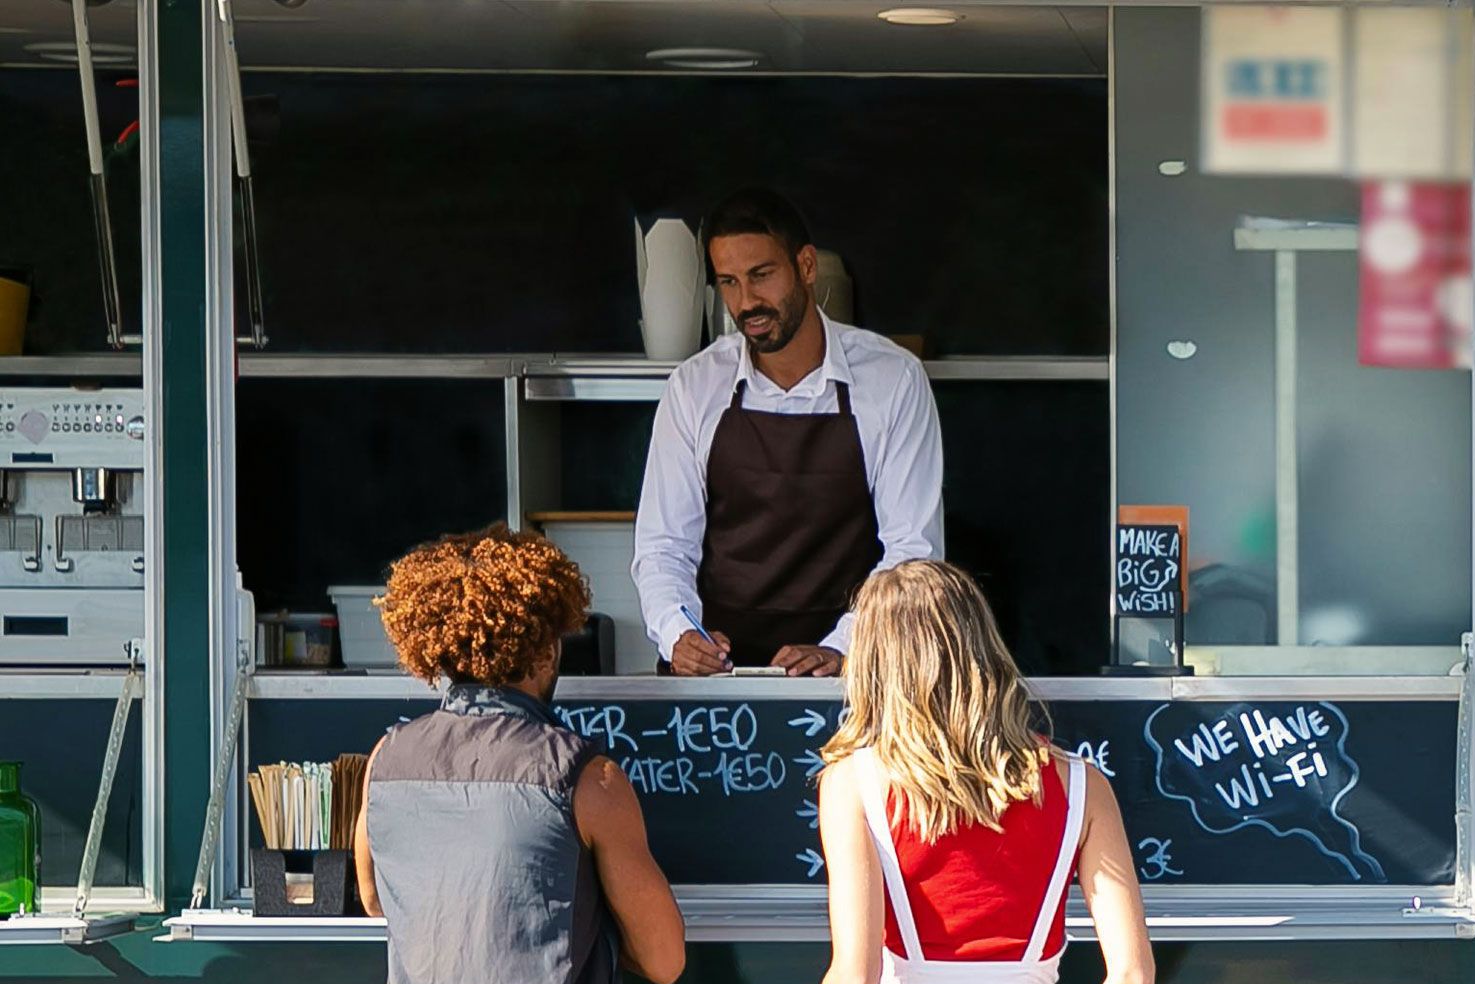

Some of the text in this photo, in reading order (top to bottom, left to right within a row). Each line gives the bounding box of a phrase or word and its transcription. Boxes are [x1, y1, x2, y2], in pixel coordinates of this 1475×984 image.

[1119, 528, 1180, 557] MAKE A
[1174, 706, 1330, 767] WE HAVE
[1215, 741, 1328, 809] Wi-Fi
